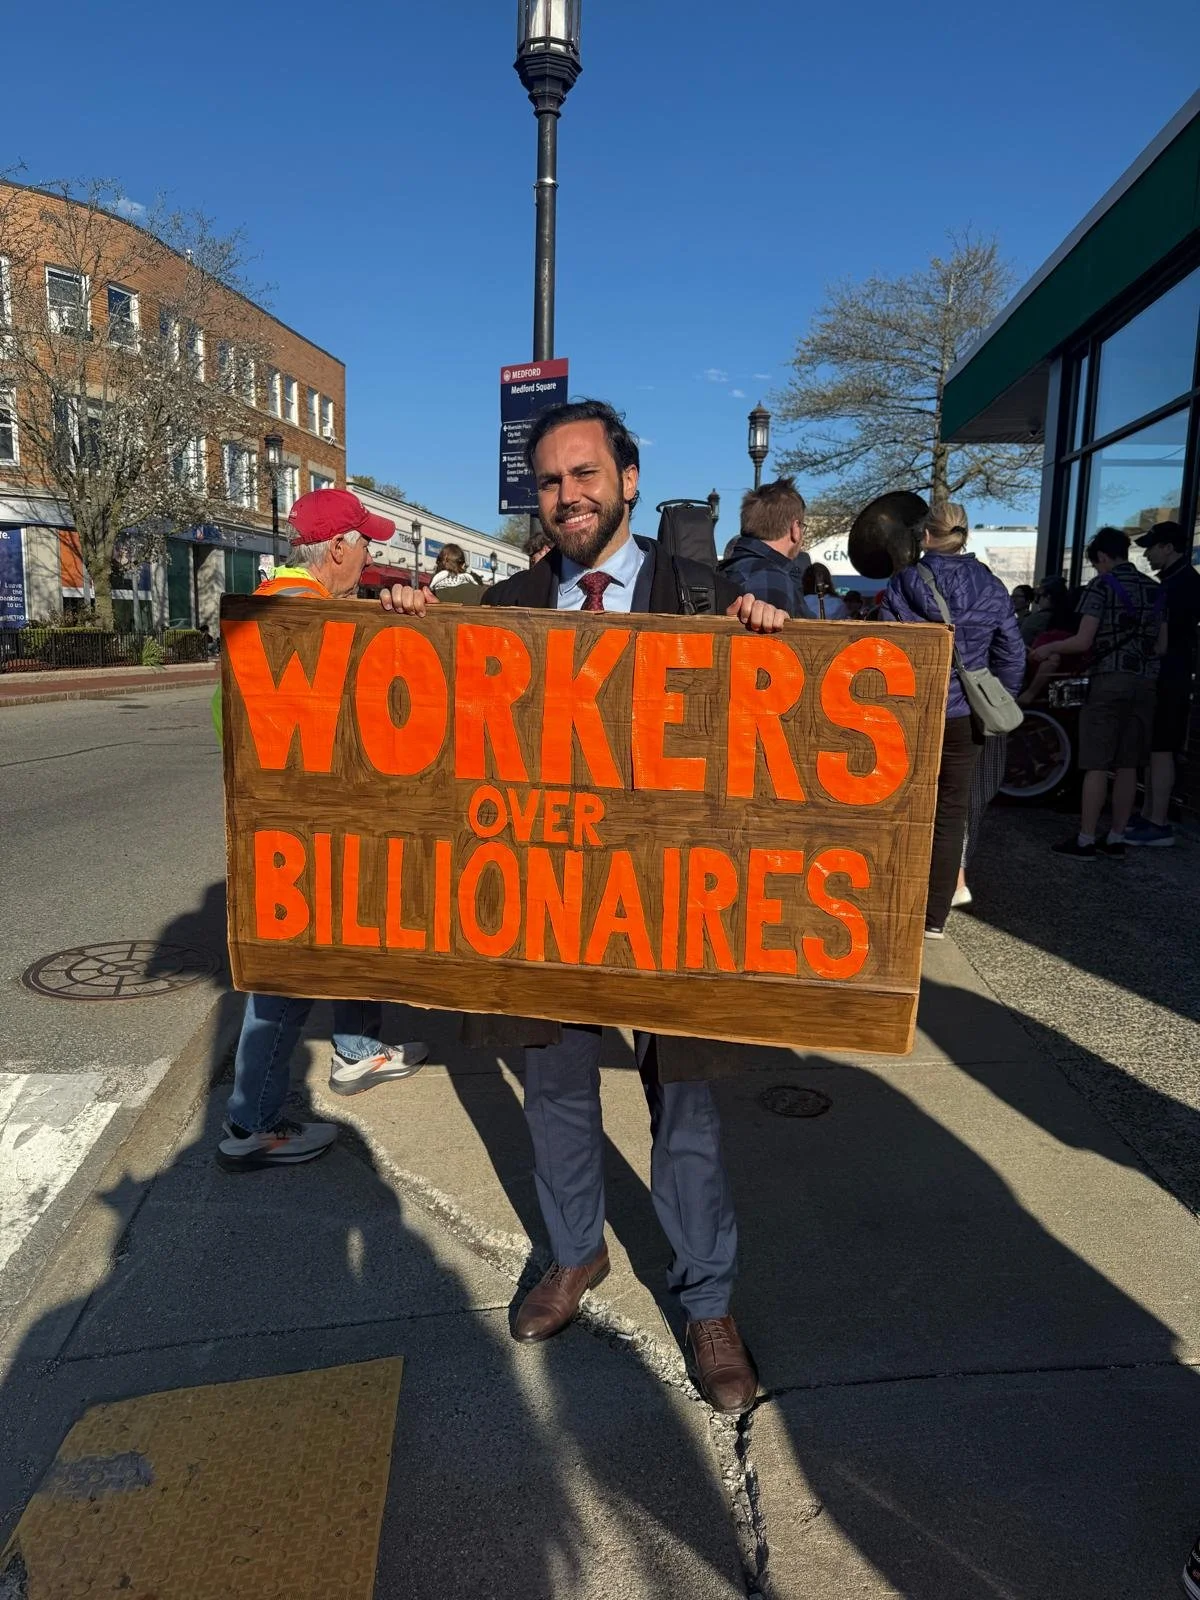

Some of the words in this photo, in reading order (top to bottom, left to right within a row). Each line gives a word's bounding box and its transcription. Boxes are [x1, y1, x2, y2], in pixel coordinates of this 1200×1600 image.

[511, 384, 535, 394] Medford
[535, 382, 557, 392] Square
[512, 368, 541, 379] MEDFORD
[223, 620, 915, 806] WORKERS
[469, 785, 605, 846] OVER
[255, 830, 870, 979] BILLIONAIRES
